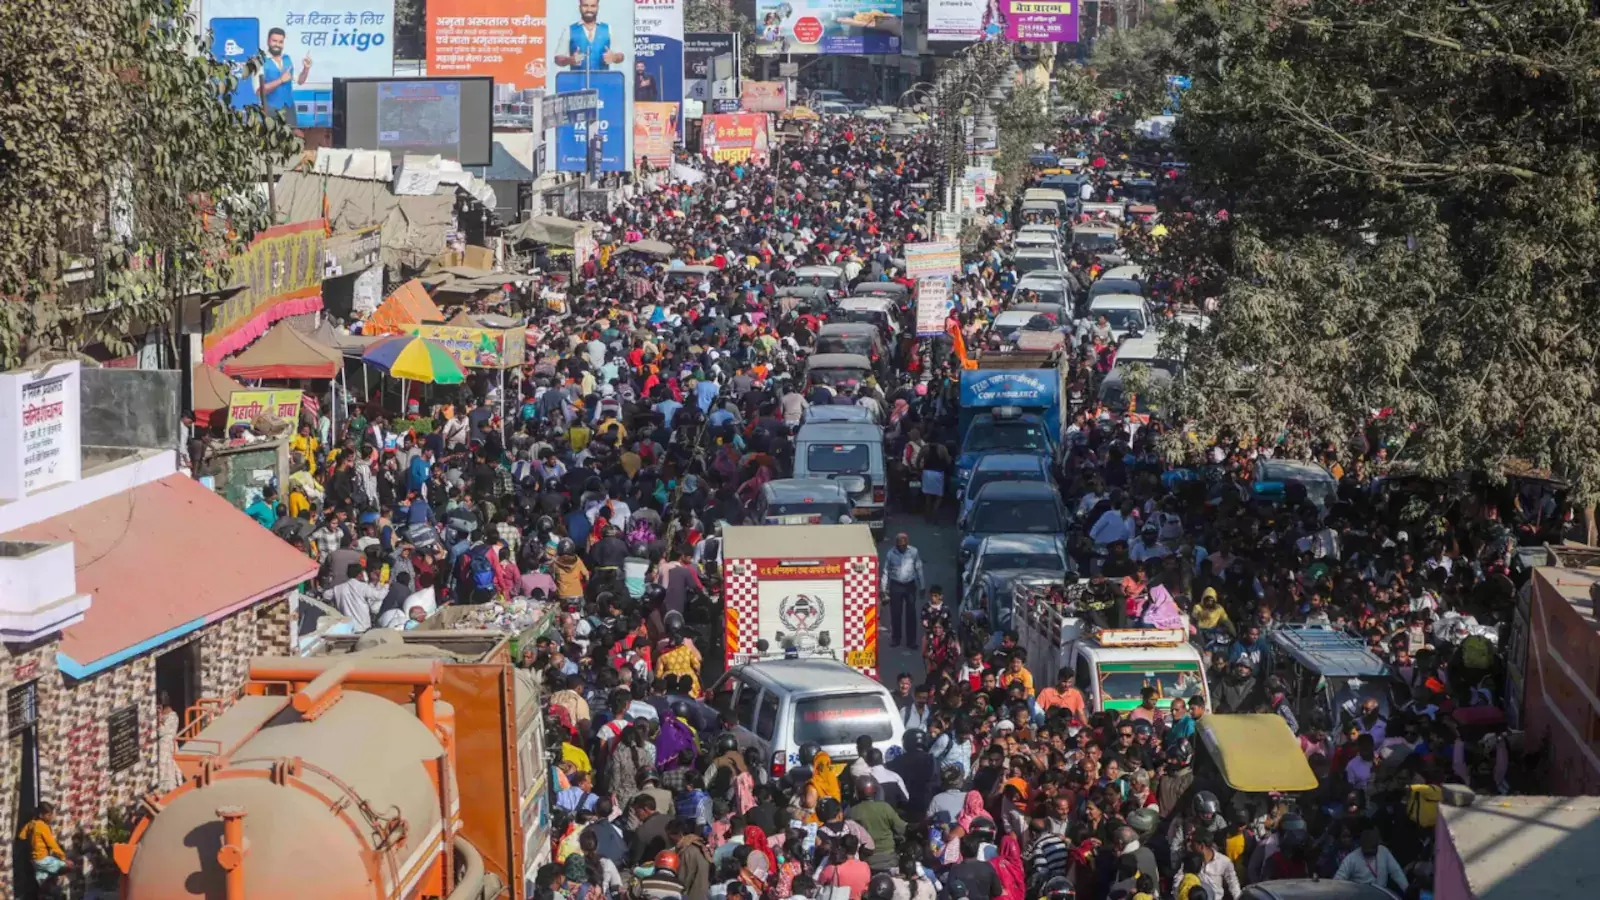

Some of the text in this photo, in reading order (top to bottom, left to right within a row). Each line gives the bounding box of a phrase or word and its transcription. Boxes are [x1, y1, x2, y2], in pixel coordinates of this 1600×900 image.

[286, 10, 385, 25] ट्रेन टिकट के लिए
[301, 28, 385, 52] बस ixigo
[482, 55, 504, 63] 2025
[978, 390, 1039, 400] COW AMBULANCE
[231, 400, 298, 420] महावीर ढाबा
